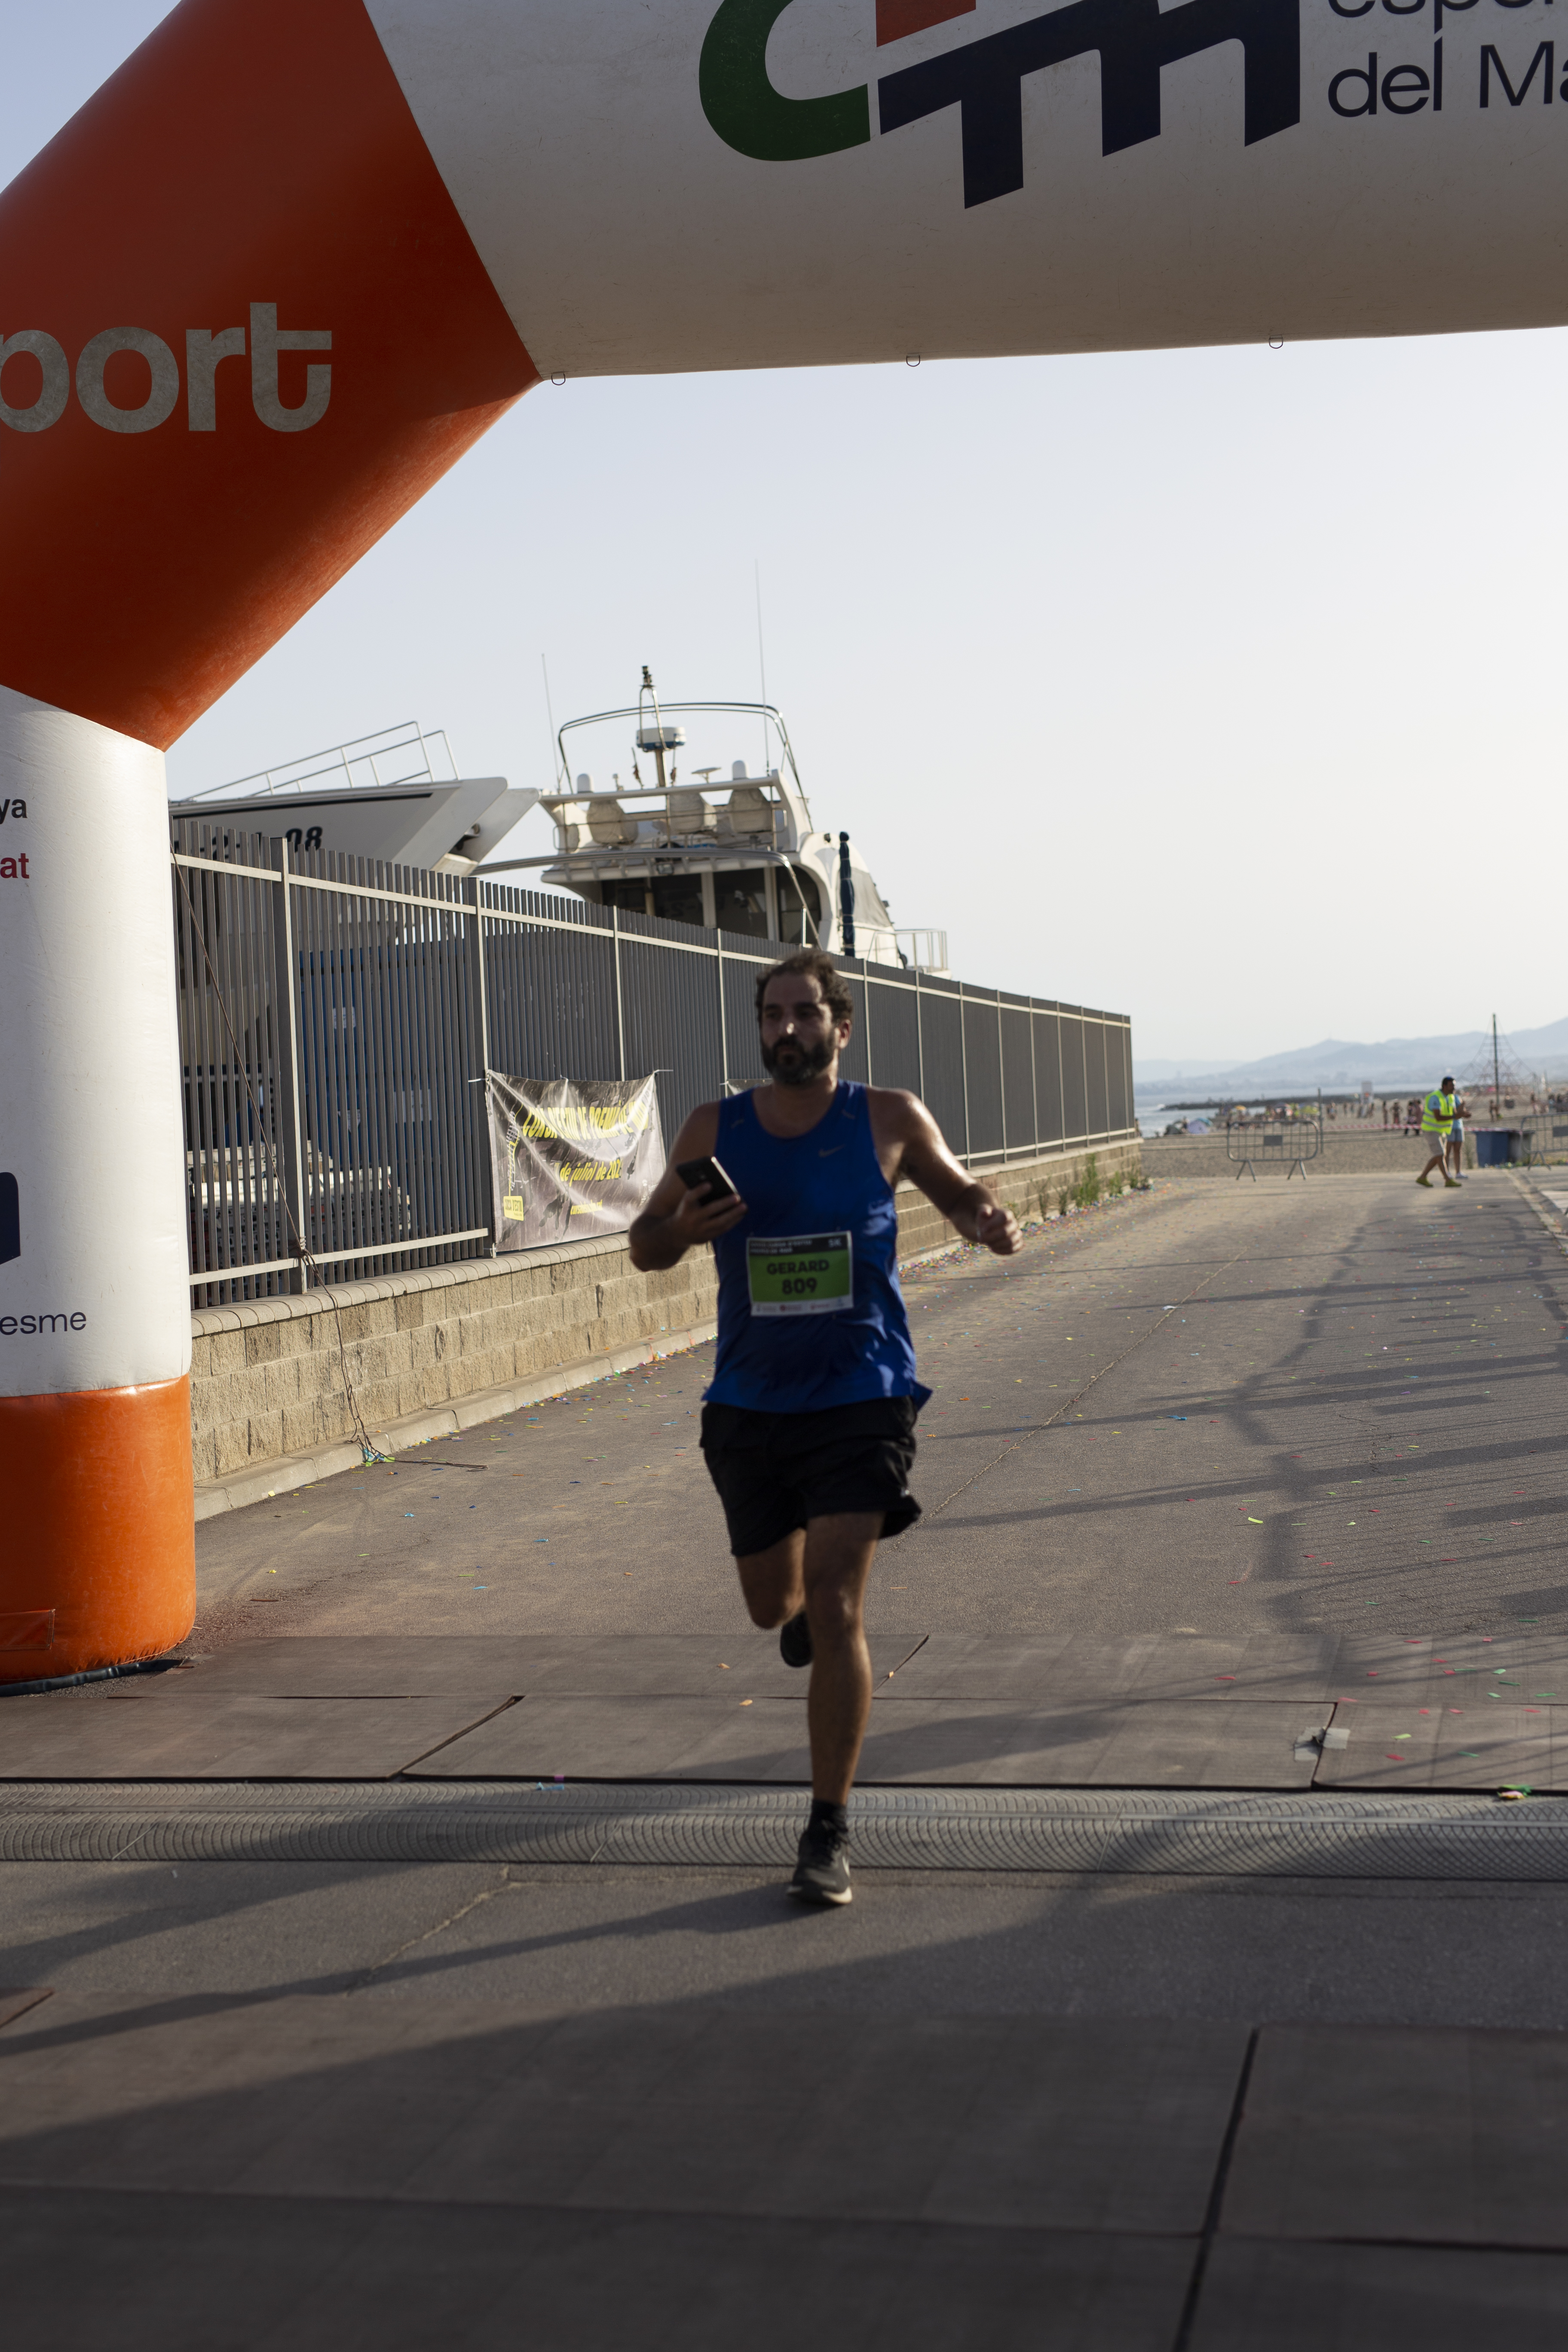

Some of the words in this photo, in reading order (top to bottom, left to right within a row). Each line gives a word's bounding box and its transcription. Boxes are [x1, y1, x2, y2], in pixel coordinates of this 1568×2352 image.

[1328, 36, 1442, 117] del
[1479, 40, 1568, 108] M
[0, 853, 30, 879] at
[560, 1162, 572, 1182] de
[569, 1161, 598, 1187] juliol
[595, 1161, 607, 1181] de
[766, 1259, 830, 1275] GERARD
[782, 1277, 818, 1295] 809
[0, 1312, 86, 1335] esme
